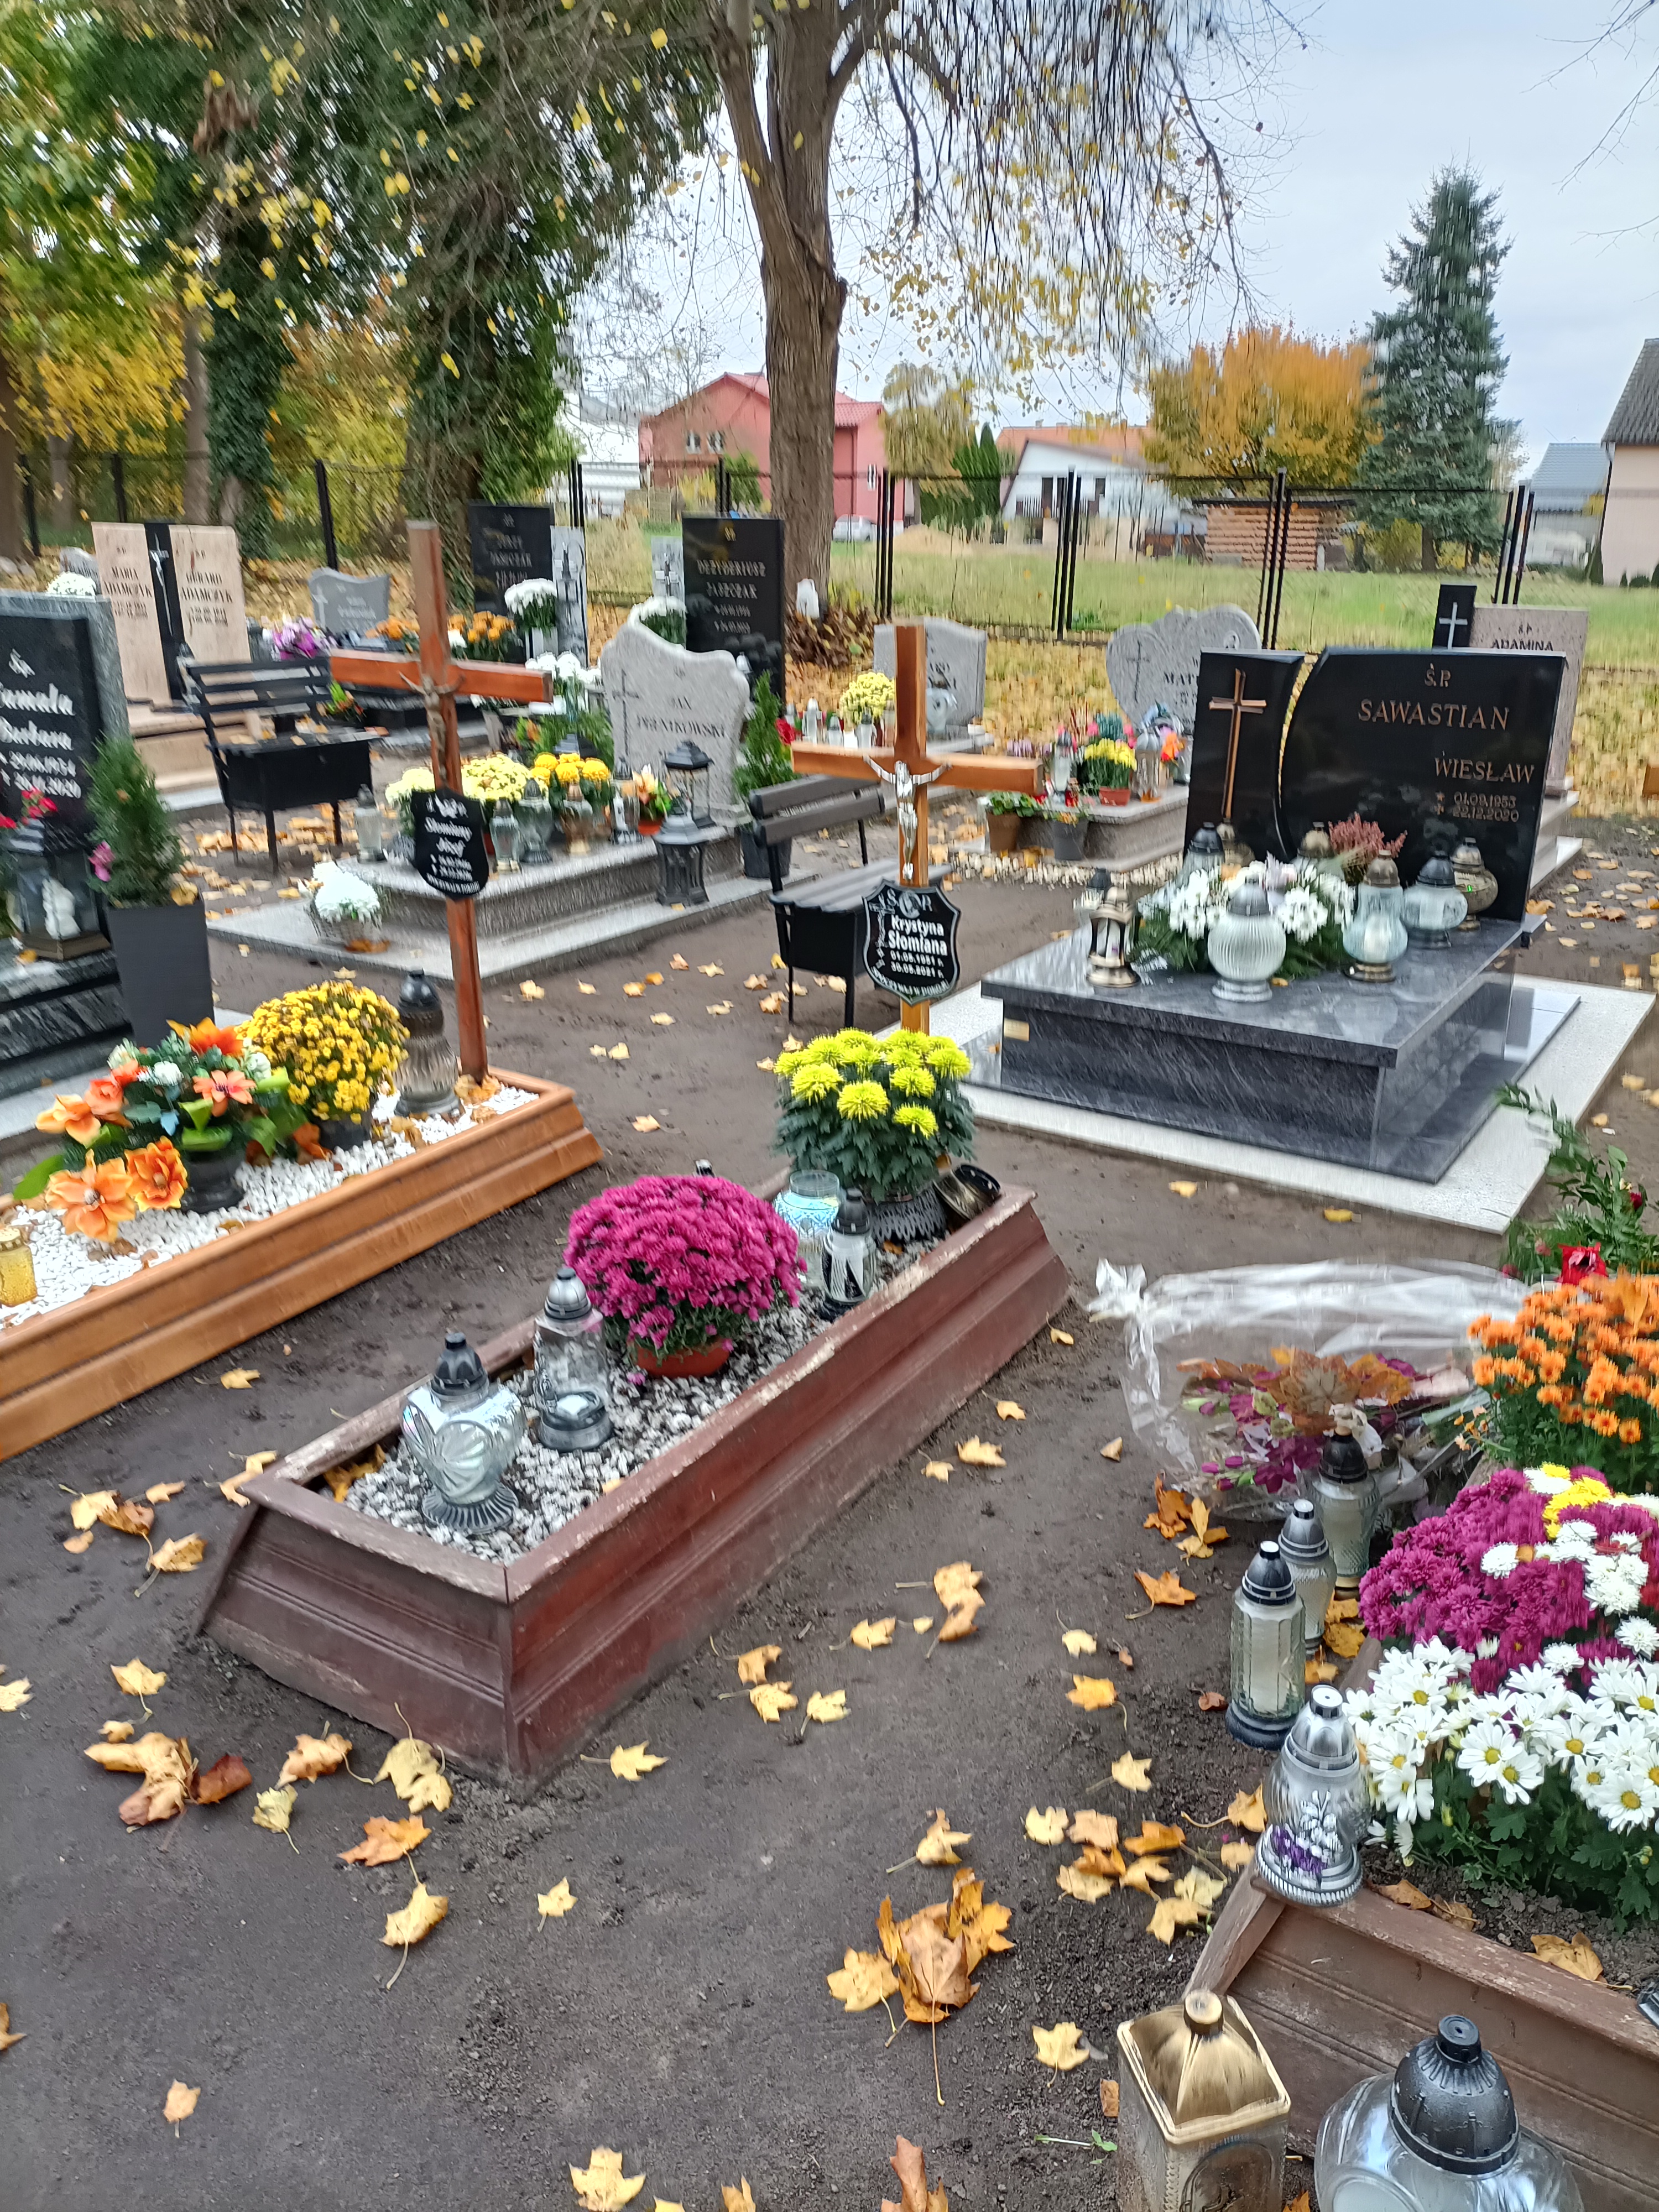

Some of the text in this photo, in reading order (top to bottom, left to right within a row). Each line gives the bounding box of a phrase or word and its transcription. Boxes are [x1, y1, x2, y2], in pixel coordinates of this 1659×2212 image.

[1358, 698, 1510, 731] SAWASTIAN
[1434, 757, 1535, 784] WIESŁAW
[891, 914, 945, 937] Krystyna
